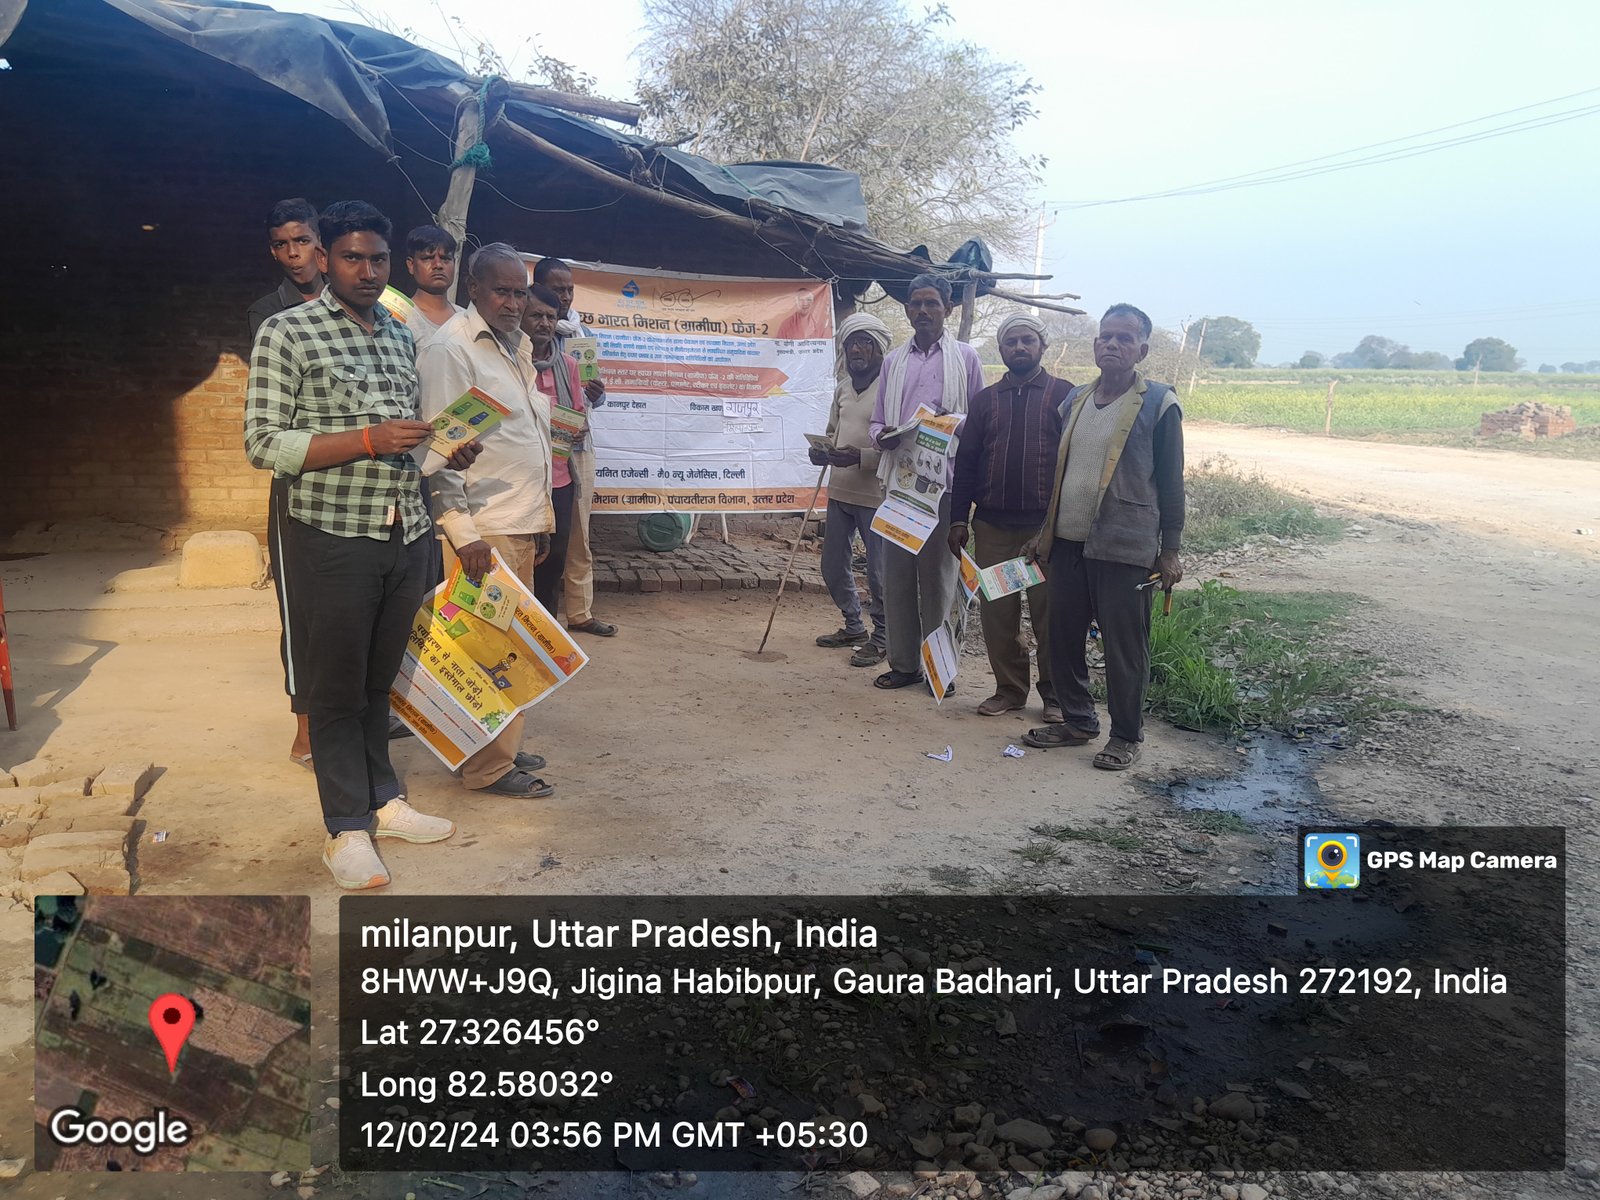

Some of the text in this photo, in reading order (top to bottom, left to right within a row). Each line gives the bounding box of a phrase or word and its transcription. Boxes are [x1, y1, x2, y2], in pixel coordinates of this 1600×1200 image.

[579, 311, 768, 335] च्छ भारत मिशन (ग्रामीण) फेज-2
[607, 400, 647, 410] कानपुर देहात
[690, 402, 709, 411] विकास
[725, 402, 759, 416] राजपुर
[595, 467, 618, 478] यनित
[621, 467, 649, 478] एजेन्सी
[672, 470, 685, 481] न्यू
[687, 468, 721, 480] जेनेसिस,
[723, 468, 745, 479] दिल्ली
[622, 493, 665, 506] (ग्रामीण),
[668, 493, 715, 504] पंचायतीराज
[719, 493, 750, 505] विभाग,
[753, 494, 773, 504] उत्तर
[776, 492, 795, 504] प्रदेश
[522, 615, 537, 632] मिशन
[417, 624, 442, 651] पर्यावरण
[442, 652, 450, 660] से
[451, 660, 465, 678] नाता
[409, 630, 430, 654] लिथिन
[430, 654, 440, 665] का
[439, 665, 465, 693] इस्तेमाल
[465, 692, 482, 711] छोड़ो
